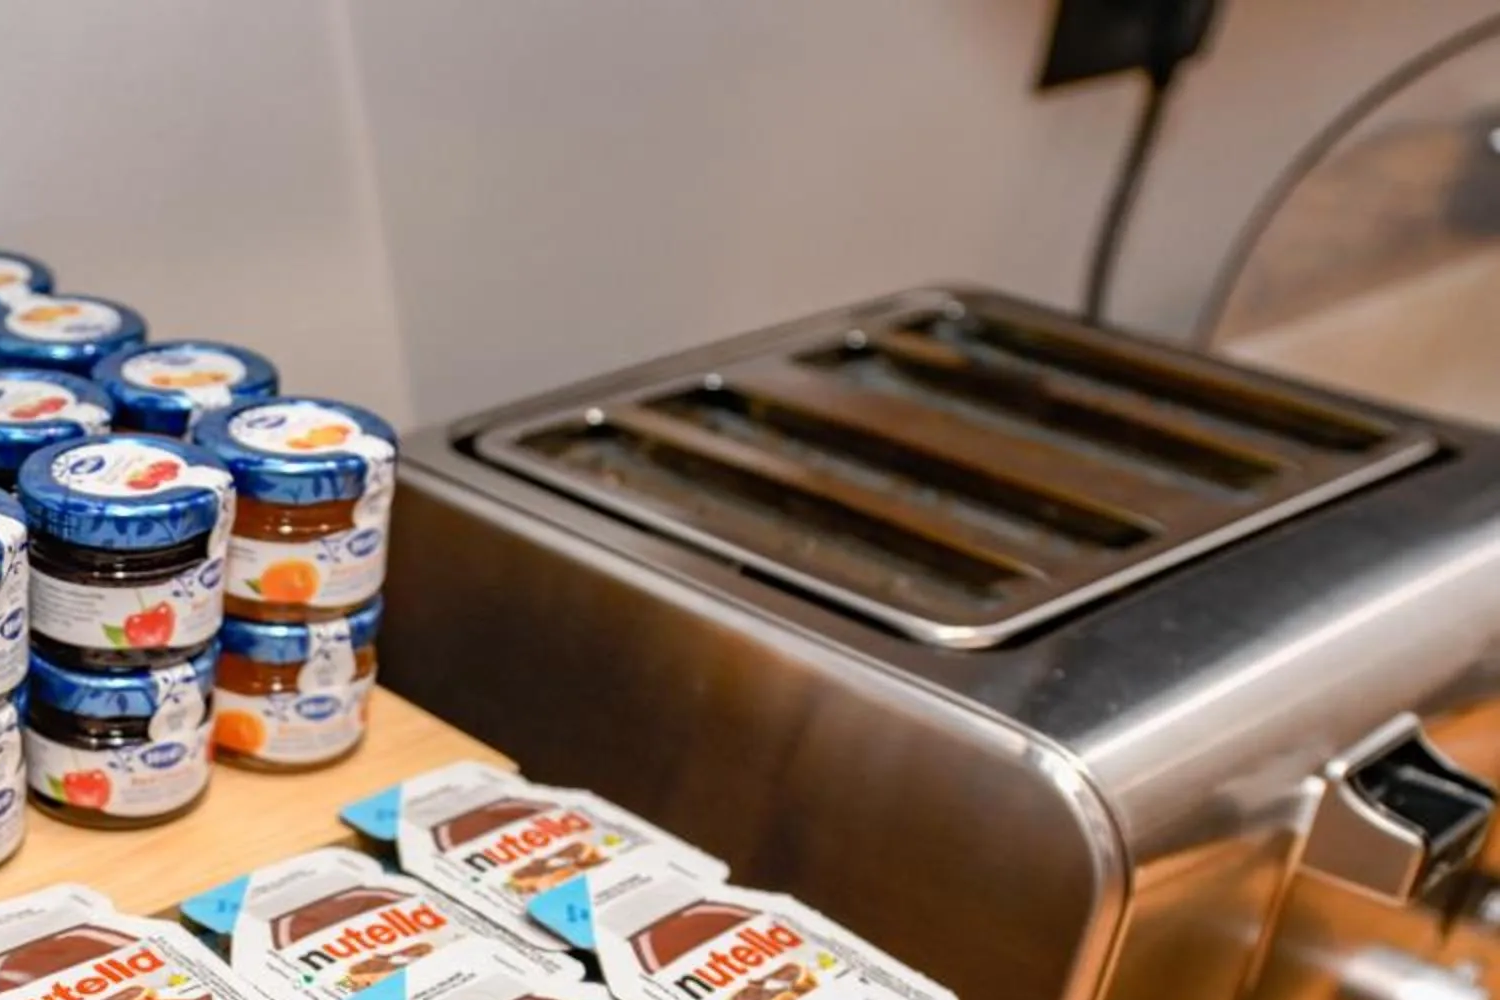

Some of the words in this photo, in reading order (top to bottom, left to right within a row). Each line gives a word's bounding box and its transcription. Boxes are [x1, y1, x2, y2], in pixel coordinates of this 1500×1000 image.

[464, 811, 593, 873] nutella
[297, 902, 448, 971] nutella
[674, 921, 803, 1000] nutella
